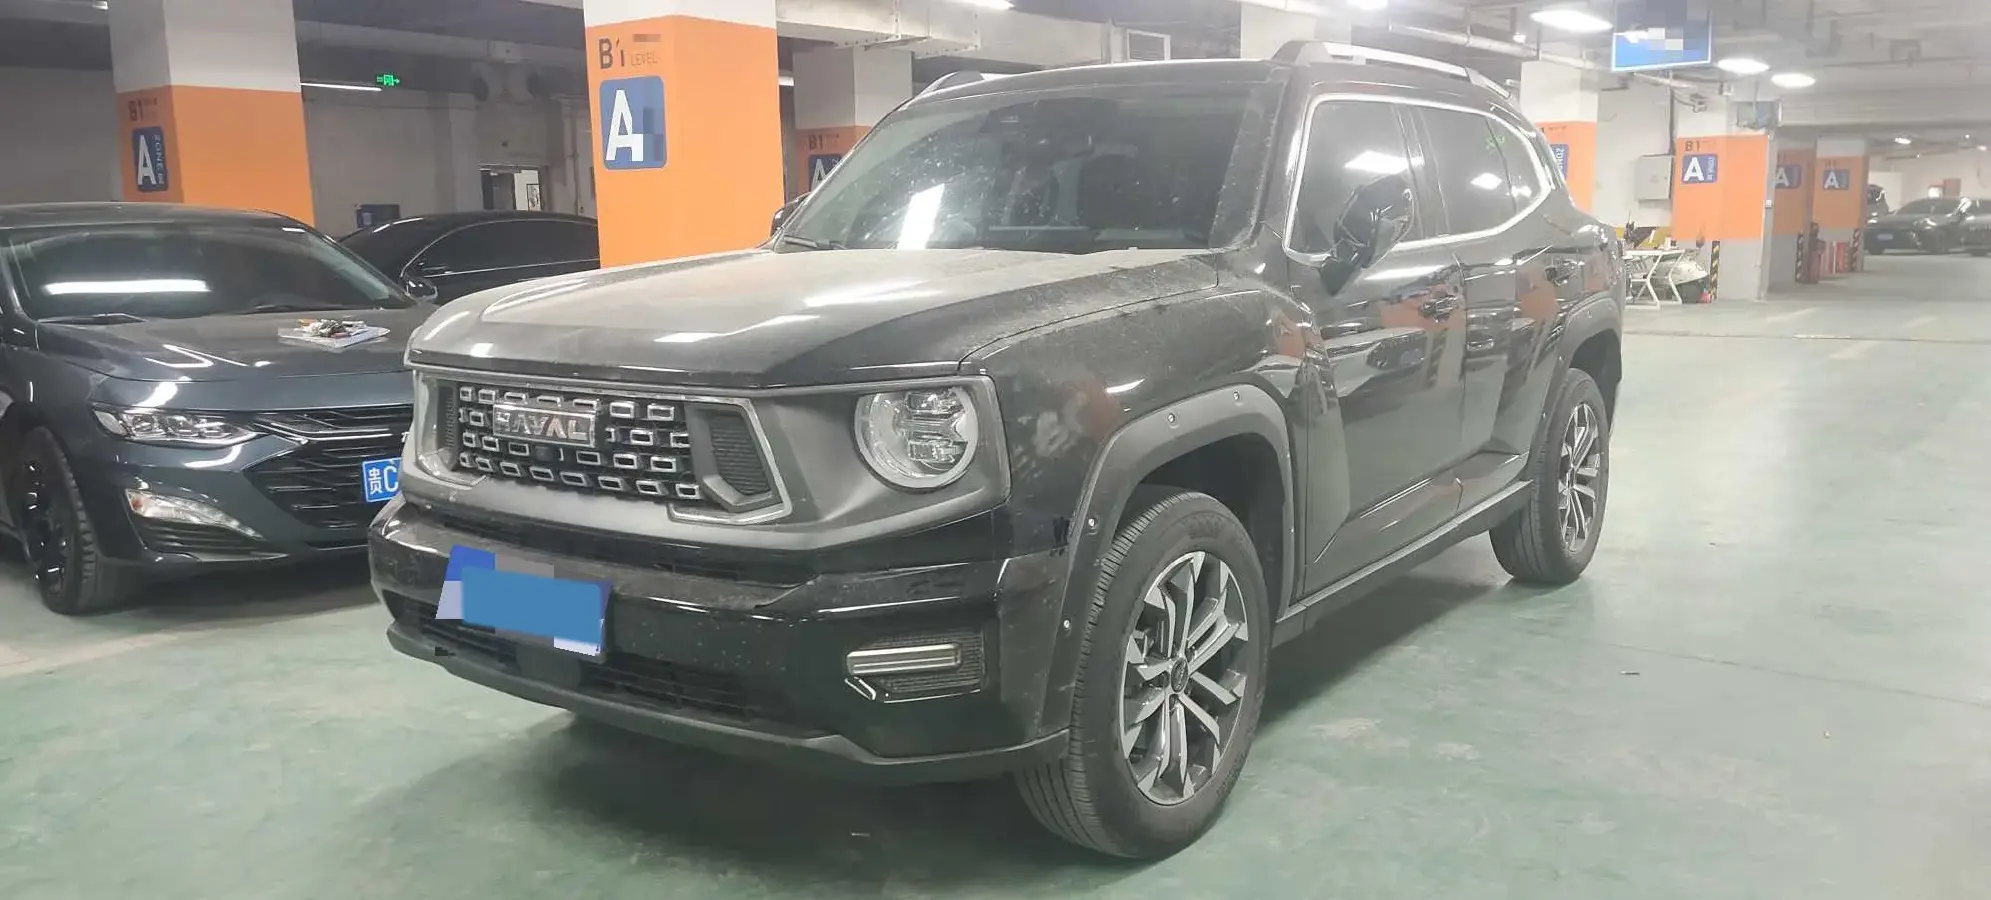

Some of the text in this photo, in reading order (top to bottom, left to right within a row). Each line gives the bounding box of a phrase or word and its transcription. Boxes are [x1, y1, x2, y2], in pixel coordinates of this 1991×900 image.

[630, 51, 659, 66] LEVEL
[605, 88, 644, 162] A
[1684, 140, 1700, 152] B1
[137, 134, 157, 185] A
[1683, 156, 1705, 182] A
[1774, 166, 1790, 187] A
[1823, 170, 1840, 189] A
[496, 410, 588, 441] HAVAL
